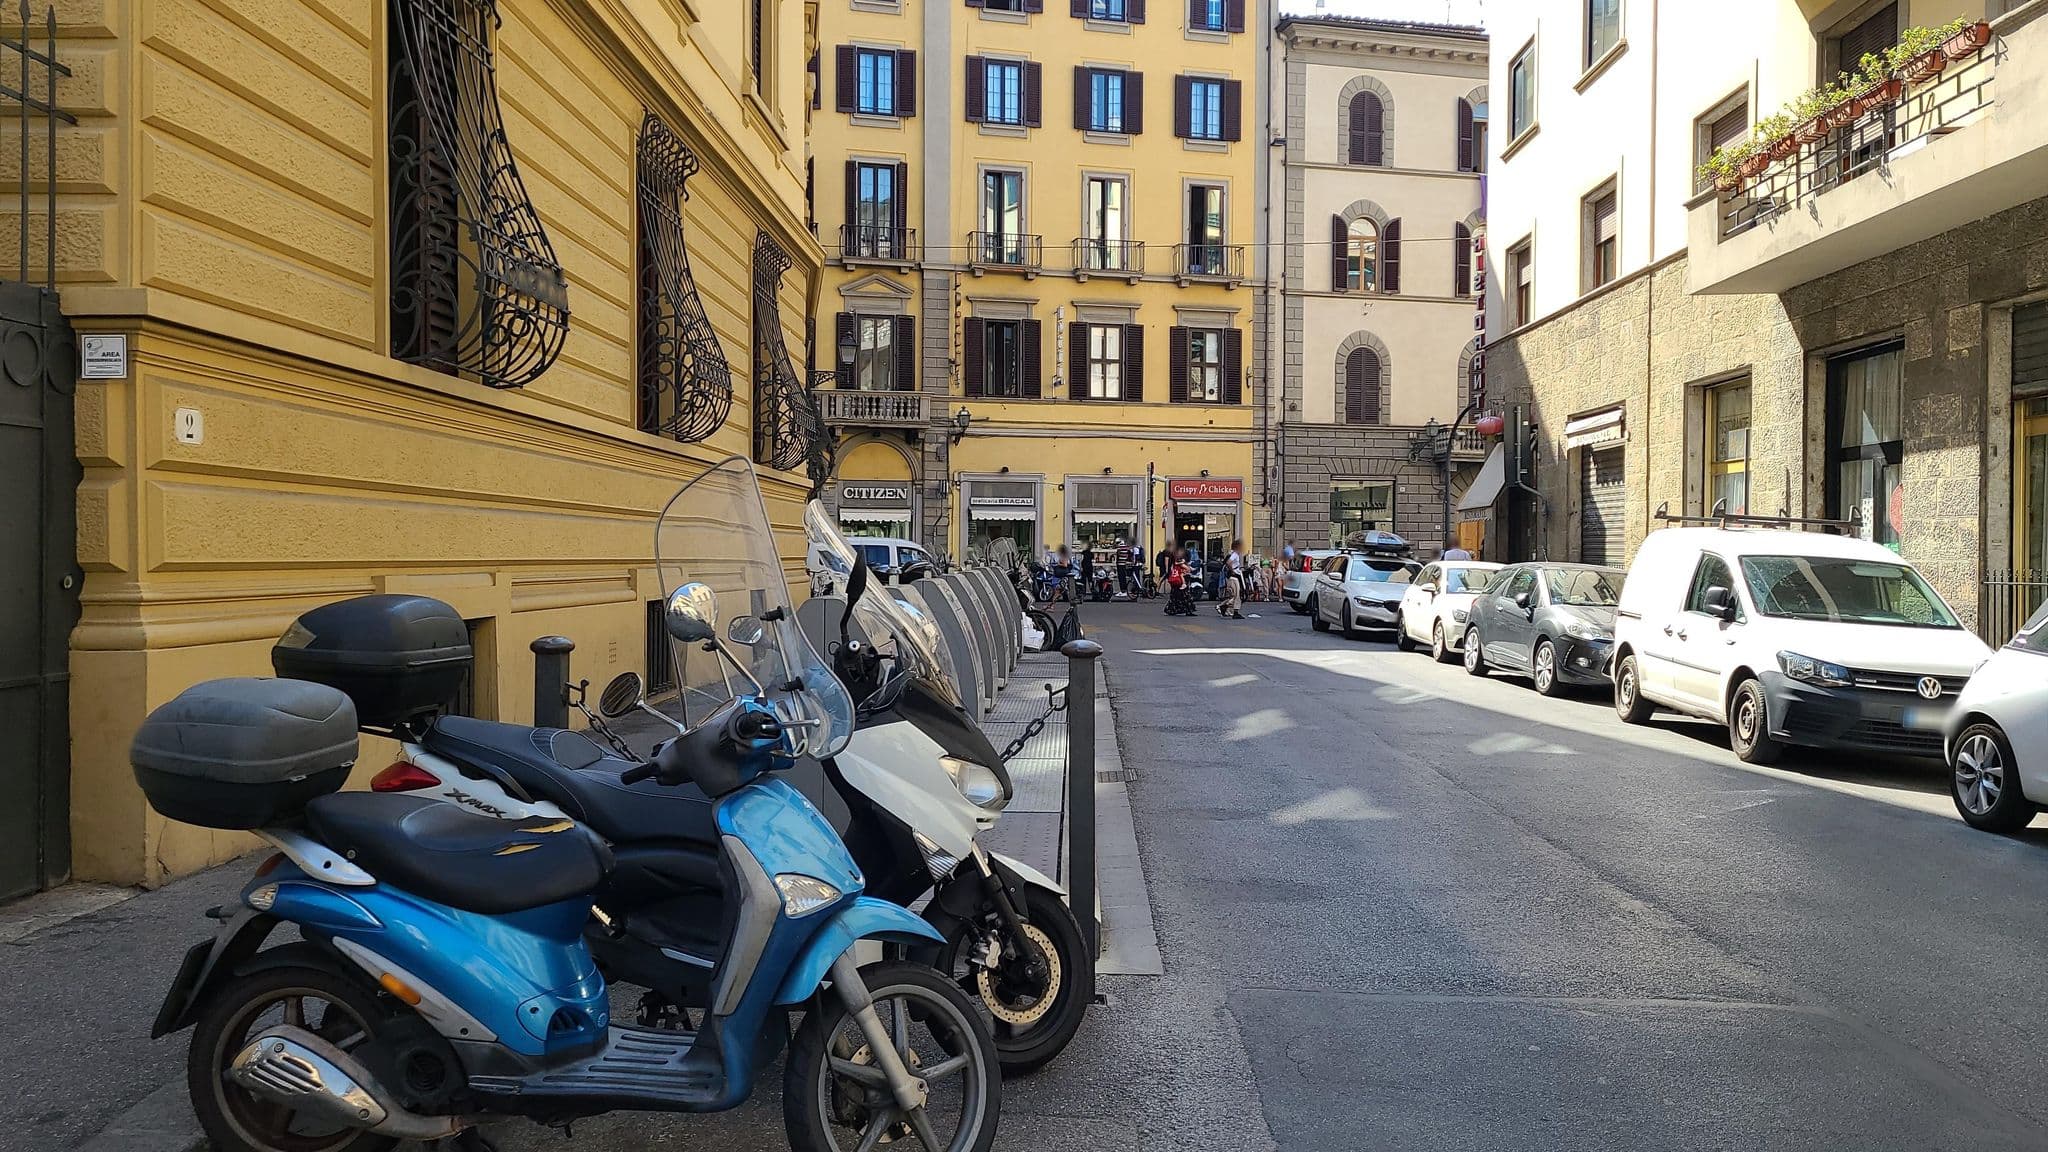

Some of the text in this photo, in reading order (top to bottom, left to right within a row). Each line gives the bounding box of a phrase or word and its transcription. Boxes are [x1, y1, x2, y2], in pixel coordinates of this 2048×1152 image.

[843, 486, 908, 499] CITIZEN
[1174, 485, 1237, 495] Crispy Chicken
